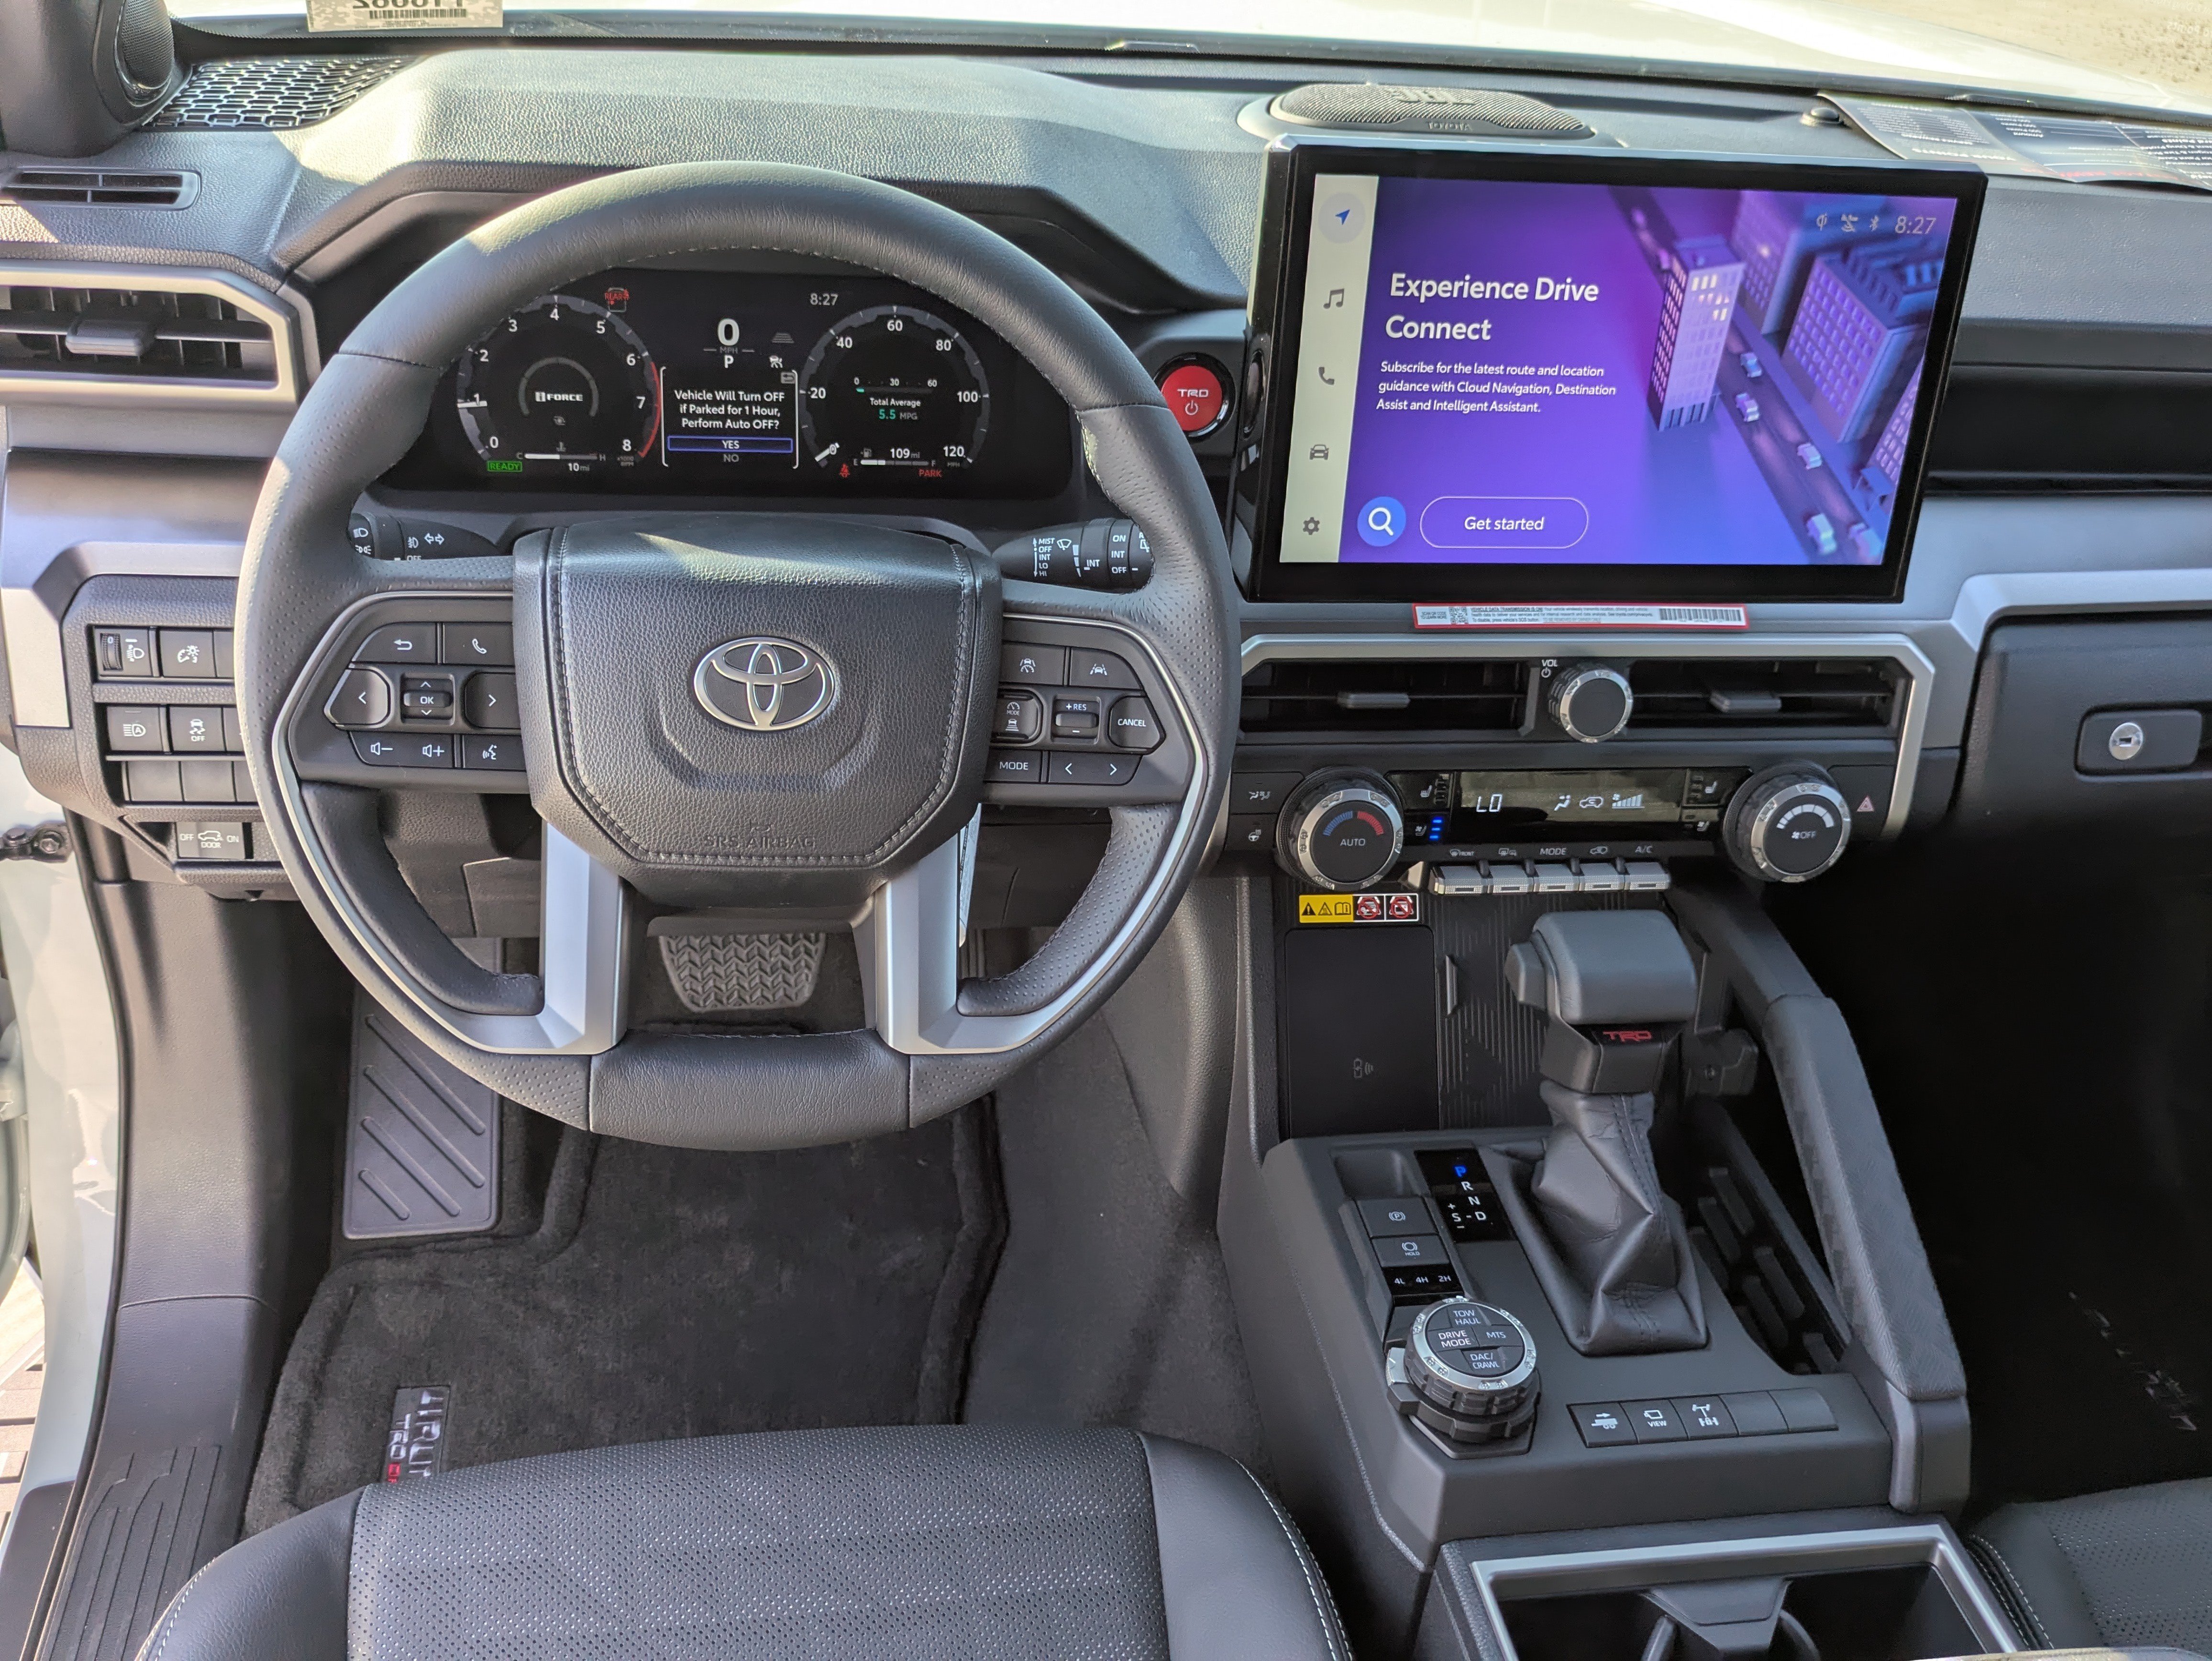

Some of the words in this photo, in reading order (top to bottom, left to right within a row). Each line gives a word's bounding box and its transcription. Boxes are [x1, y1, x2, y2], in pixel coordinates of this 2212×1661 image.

[1895, 215, 1936, 234] 8:27
[1390, 273, 1529, 303] Experience
[1535, 277, 1599, 302] Drive
[810, 293, 839, 306] 8:27
[550, 308, 559, 321] 4
[509, 319, 518, 332] 3
[597, 321, 606, 334] 5
[887, 320, 903, 332] 60
[1386, 315, 1492, 341] Connect
[719, 318, 740, 346] 0
[836, 336, 853, 348] 40
[936, 339, 952, 351] 80
[480, 349, 489, 362] 2
[627, 354, 636, 366] 6
[724, 355, 734, 368] P
[1380, 360, 1434, 374] Subscribe
[1436, 362, 1452, 375] for
[1453, 363, 1472, 375] the
[1473, 363, 1504, 376] latest
[1506, 365, 1535, 376] route
[1537, 365, 1558, 376] and
[1560, 365, 1604, 377] location
[854, 377, 859, 385] 0
[890, 378, 899, 386] 30
[927, 379, 938, 387] 60
[1378, 380, 1429, 394] guidance
[1431, 382, 1455, 394] with
[1457, 382, 1490, 394] Cloud
[1492, 383, 1553, 396] Navigation,
[1555, 384, 1616, 396] Destination
[674, 389, 713, 401] Vehicle
[715, 390, 736, 401] Will
[738, 391, 761, 401] Turn
[763, 392, 785, 401] OFF
[810, 387, 826, 399] 20
[957, 391, 978, 402] 100
[1177, 388, 1209, 398] TRD
[636, 397, 645, 409] 7
[870, 398, 889, 406] Total
[890, 399, 921, 408] Average
[1376, 399, 1408, 410] Assist
[1409, 400, 1431, 411] and
[1433, 400, 1488, 414] Intelligent
[1489, 401, 1541, 413] Assistant.
[680, 403, 687, 414] if
[689, 404, 725, 415] Parked
[727, 404, 742, 415] for
[745, 405, 750, 415] 1
[752, 405, 780, 417] Hour,
[879, 409, 896, 420] 5.5
[900, 412, 918, 420] MPG
[682, 418, 723, 429] Perform
[725, 419, 750, 429] Auto
[752, 420, 779, 429] OFF?
[490, 436, 498, 448] 0
[622, 439, 631, 452] 8
[722, 440, 740, 449] YES
[890, 448, 909, 459] 109
[943, 446, 964, 457] 120
[723, 454, 740, 462] NO
[490, 462, 520, 471] READY
[568, 463, 579, 472] 10
[919, 469, 941, 477] PARK
[1464, 516, 1491, 531] Get
[1493, 516, 1545, 531] started
[1087, 559, 1100, 567] INT
[420, 696, 434, 704] OK
[1117, 719, 1146, 727] CANCEL
[999, 762, 1029, 770] MODE
[1476, 793, 1503, 812] LO
[226, 835, 239, 843] ON
[1800, 831, 1817, 839] OFF
[705, 835, 740, 848] SRS
[745, 836, 816, 849] AIRBAG
[1340, 838, 1366, 846] AUTO
[1635, 845, 1653, 853] A/C
[1604, 1030, 1653, 1042] TRD
[1454, 1165, 1467, 1178] P
[1461, 1181, 1473, 1191] R
[1468, 1196, 1481, 1206] N
[1452, 1213, 1461, 1222] S
[1475, 1211, 1487, 1220] D
[1438, 1330, 1468, 1340] DRIVE
[1441, 1339, 1471, 1348] MODE
[1470, 1353, 1493, 1361] DAC/
